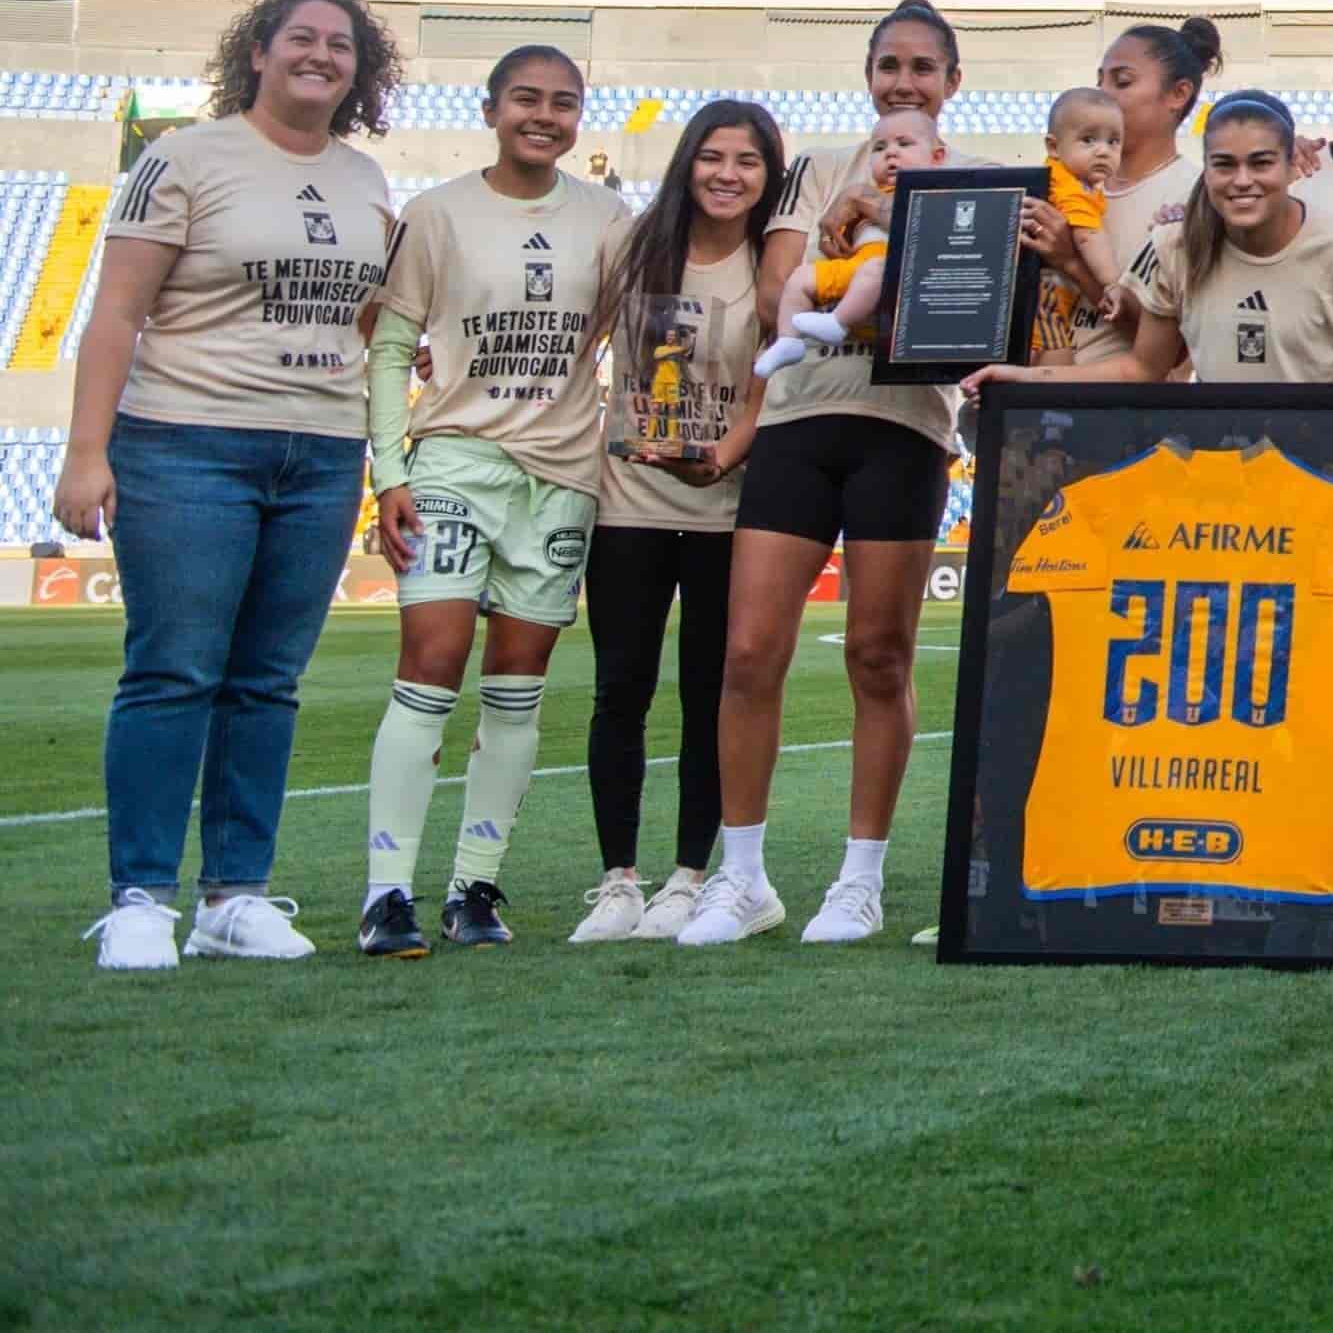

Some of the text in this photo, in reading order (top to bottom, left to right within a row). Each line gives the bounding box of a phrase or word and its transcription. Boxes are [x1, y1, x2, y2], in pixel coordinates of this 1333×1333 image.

[242, 260, 268, 281] TE
[275, 258, 354, 281] METISTE
[262, 281, 283, 301] LA
[462, 316, 482, 338] TE
[486, 311, 557, 332] METISTE
[492, 334, 575, 355] DAMISELA
[468, 357, 568, 378] EQUIVOCADA
[432, 521, 479, 575] 27
[1168, 522, 1296, 555] AFIRME
[1103, 579, 1297, 727] 200
[1111, 755, 1263, 794] VILLARREAL
[1138, 828, 1231, 851] H-E-B
